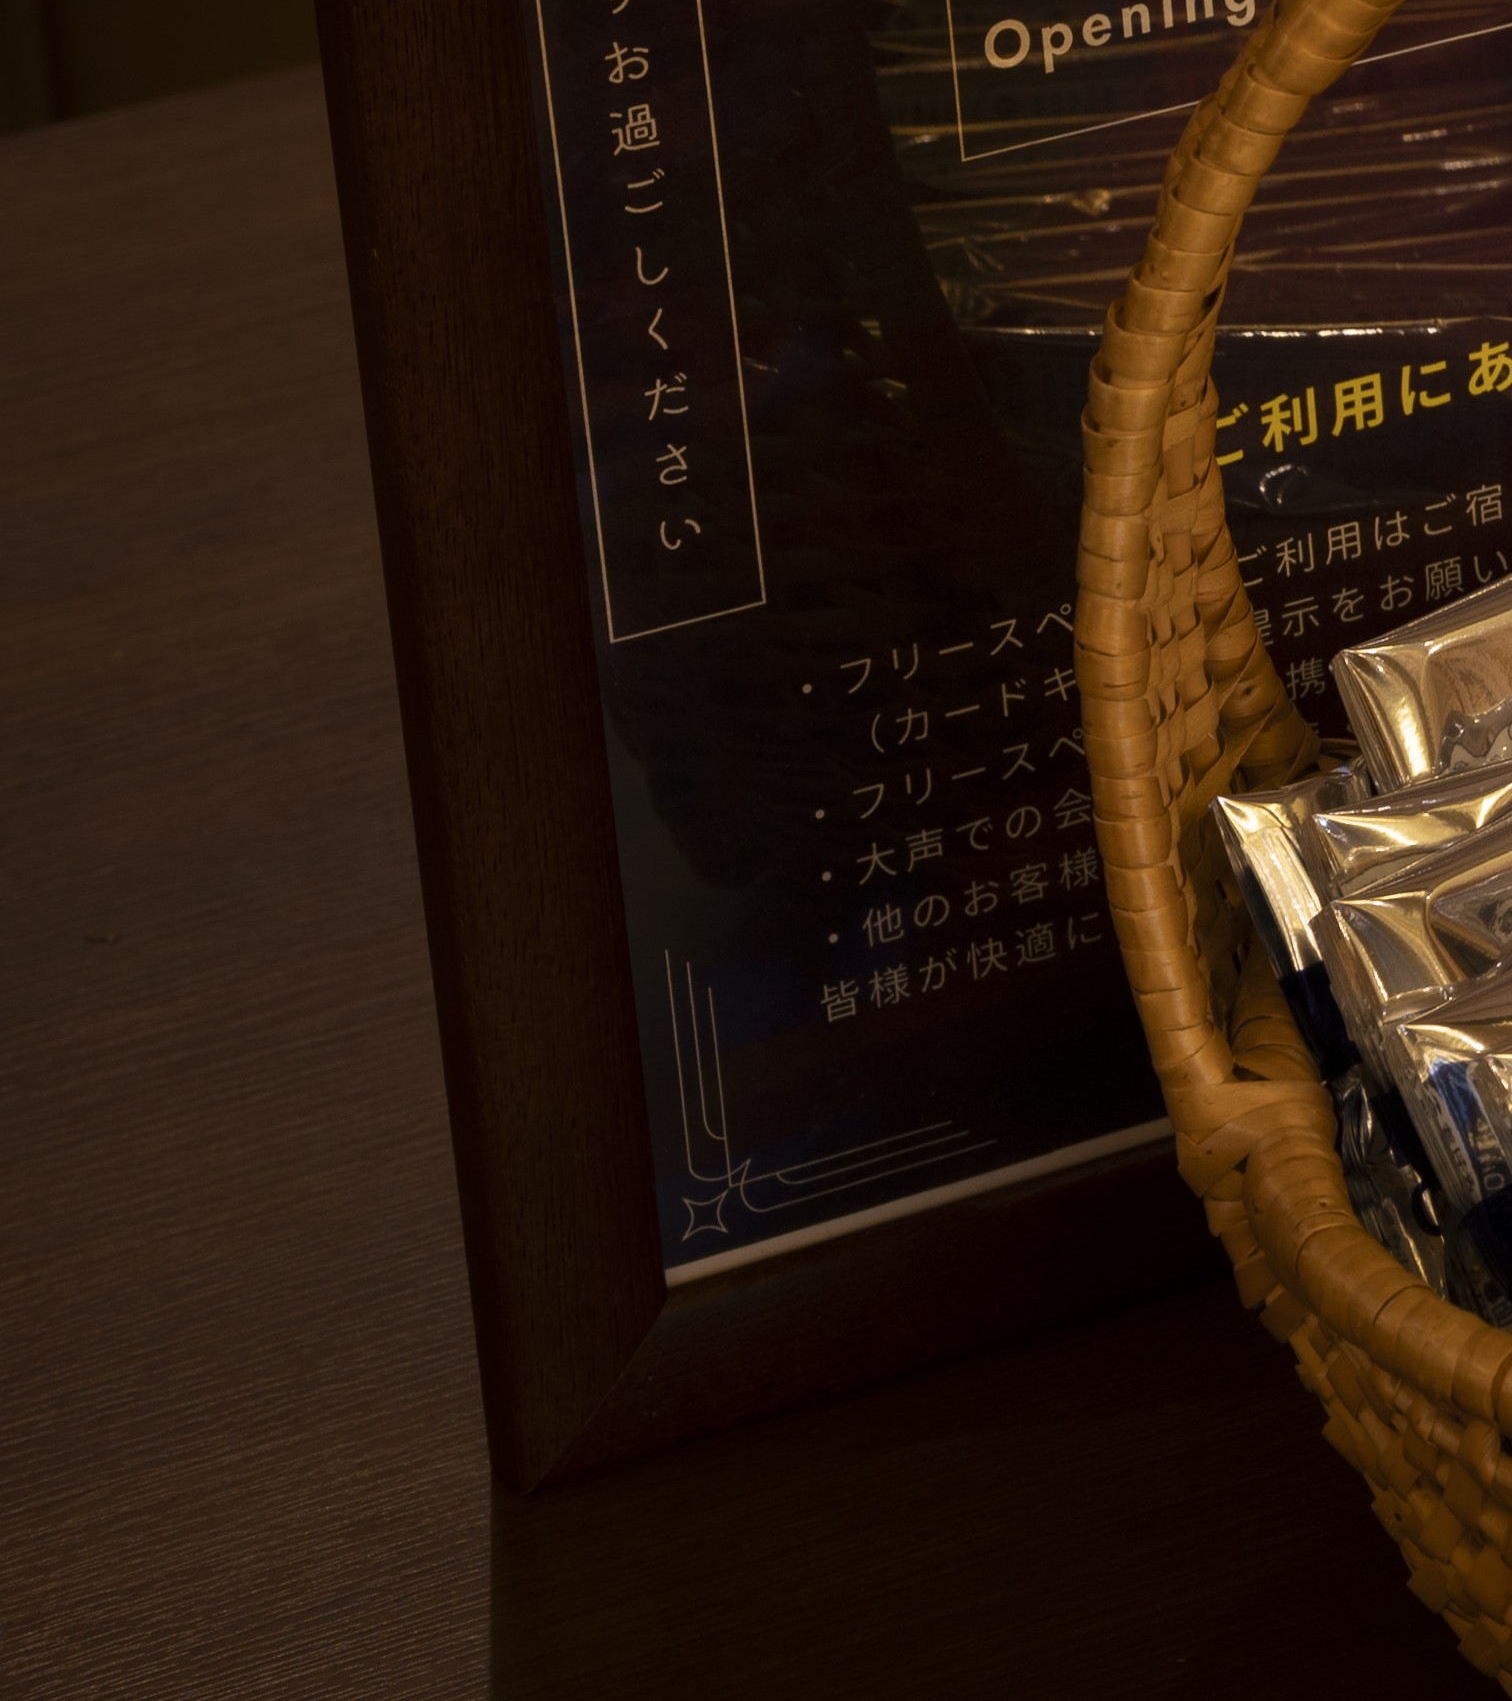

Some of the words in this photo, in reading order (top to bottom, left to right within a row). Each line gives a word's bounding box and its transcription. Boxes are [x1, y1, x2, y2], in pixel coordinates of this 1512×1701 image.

[819, 910, 1105, 1025] 皆様が快適に
